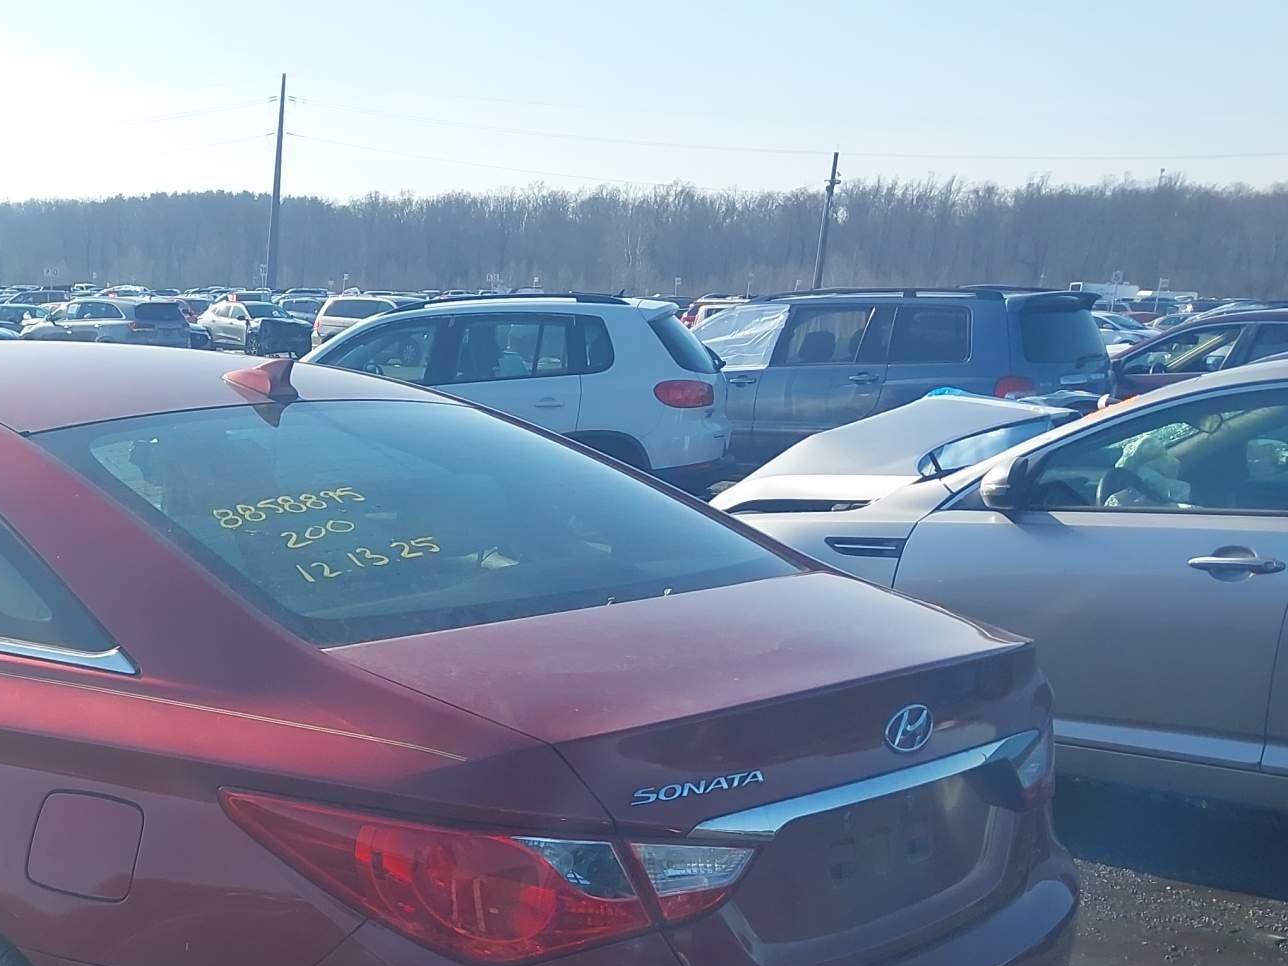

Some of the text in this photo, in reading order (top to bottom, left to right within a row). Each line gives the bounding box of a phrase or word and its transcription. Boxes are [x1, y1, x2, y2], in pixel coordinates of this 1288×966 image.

[213, 486, 366, 529] 8858895
[280, 520, 355, 549] 200
[630, 769, 765, 807] SONATA
